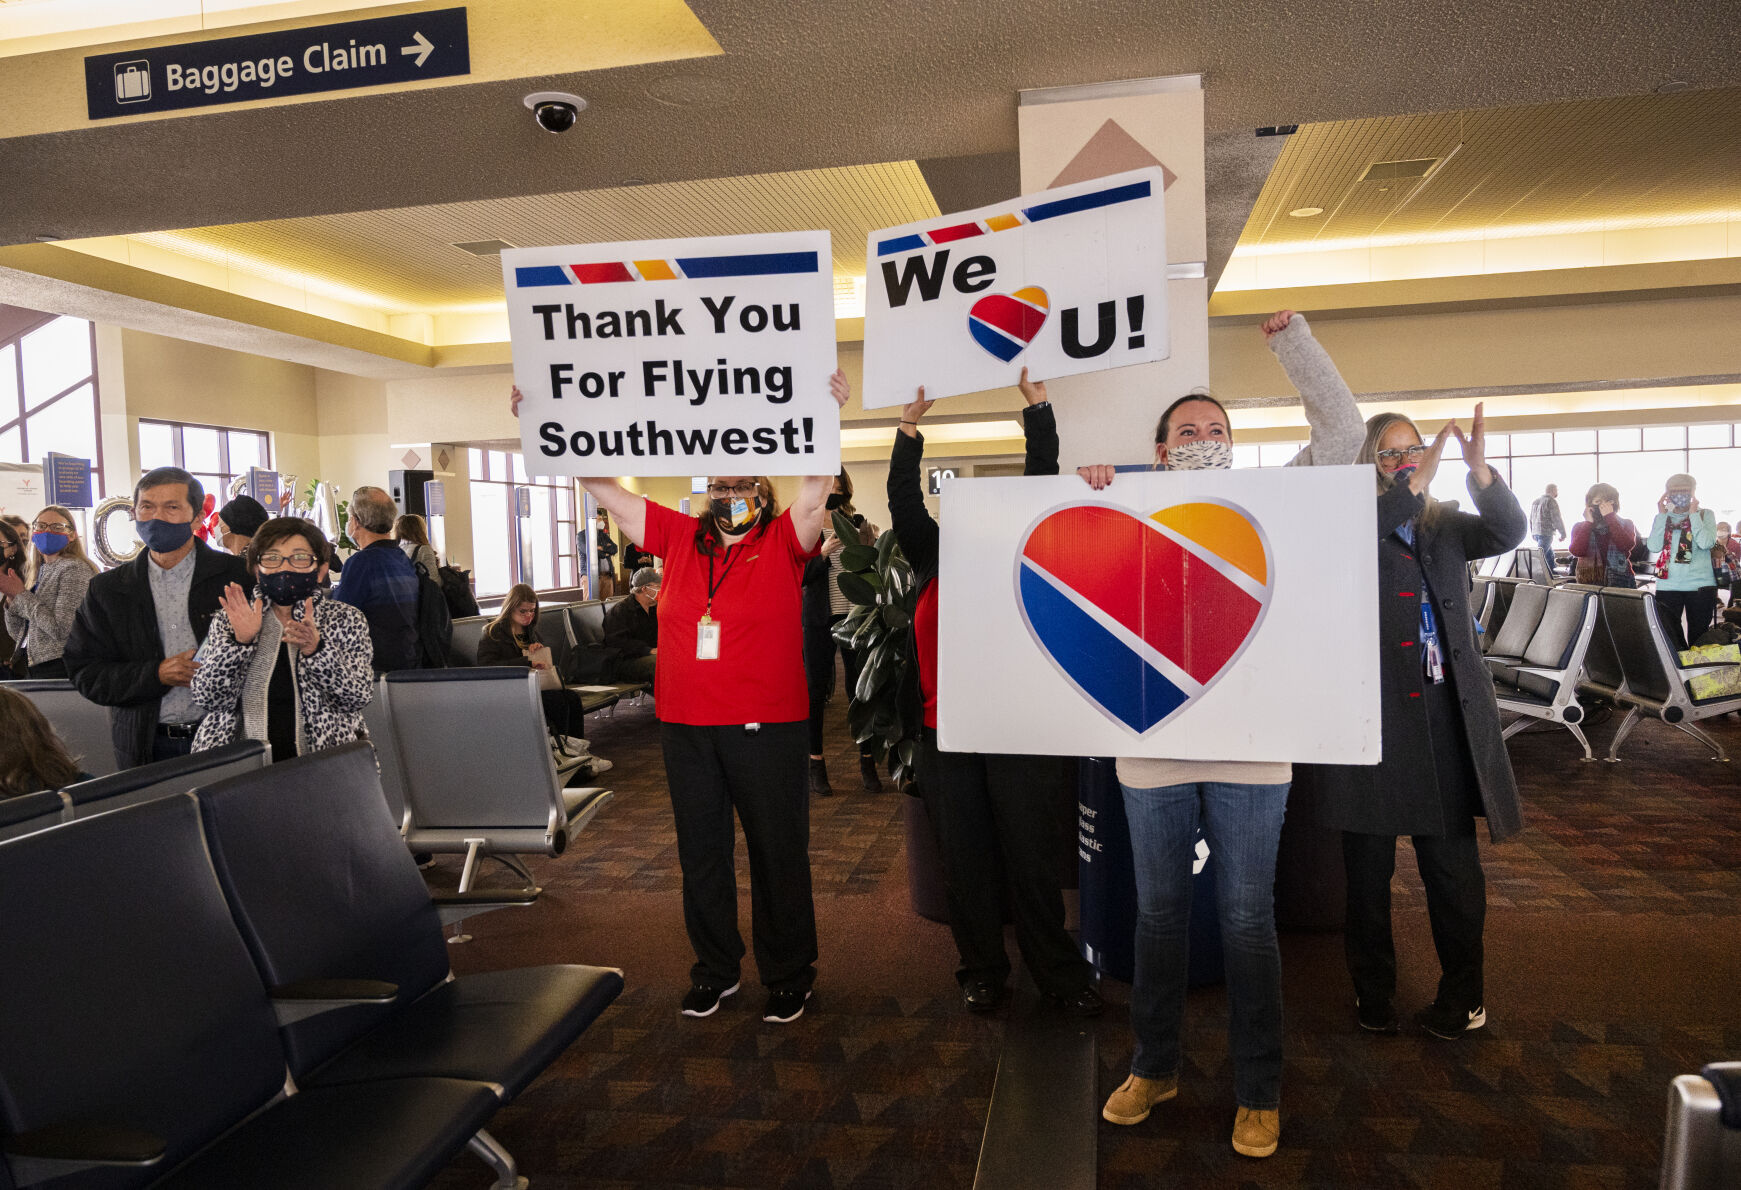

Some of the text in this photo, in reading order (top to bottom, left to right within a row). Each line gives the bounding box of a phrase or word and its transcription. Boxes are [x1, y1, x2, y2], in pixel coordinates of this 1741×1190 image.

[165, 39, 387, 95] Baggage Claim
[880, 248, 997, 309] We
[532, 295, 801, 341] Thank You
[1060, 294, 1146, 360] U!
[549, 358, 794, 406] For Flying
[539, 417, 815, 458] Southwest!
[1078, 801, 1097, 819] aper
